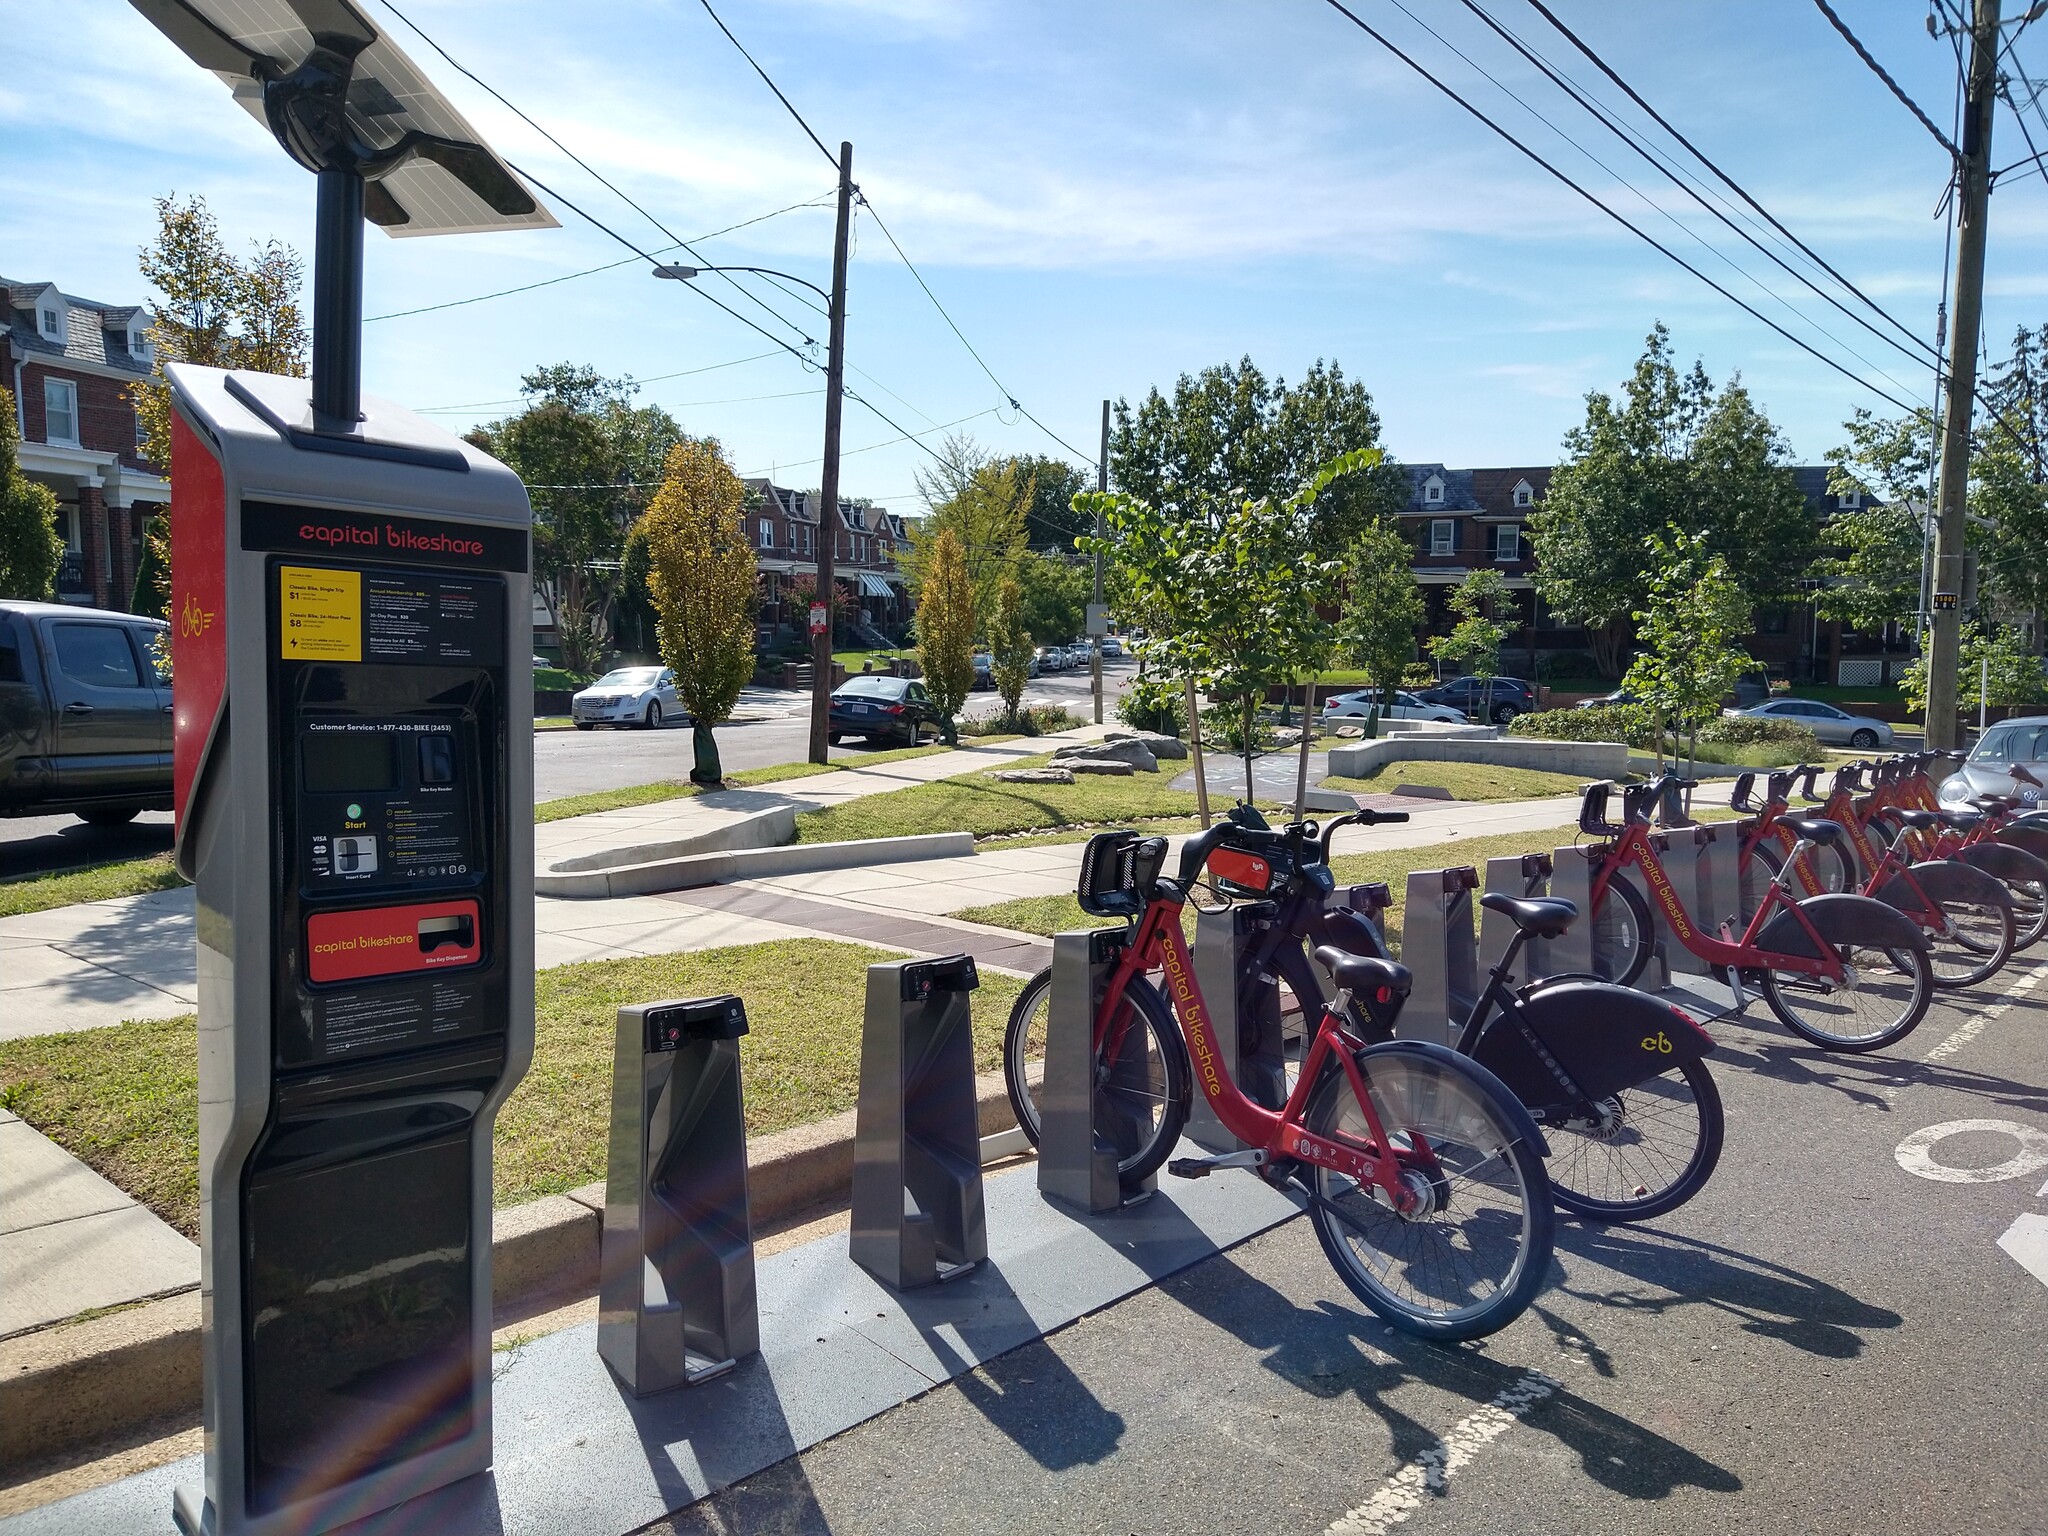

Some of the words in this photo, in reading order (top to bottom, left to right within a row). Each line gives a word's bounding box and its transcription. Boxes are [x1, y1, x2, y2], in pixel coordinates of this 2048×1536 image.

[299, 525, 378, 547] capital
[386, 523, 484, 555] bikeshare
[289, 592, 299, 600] $1
[290, 619, 301, 627] $8
[430, 724, 452, 732] (2453)
[1252, 862, 1264, 871] lyft
[1639, 847, 1666, 886] capital
[1660, 886, 1690, 939] bikeshare
[314, 938, 356, 954] capital
[359, 934, 413, 948] bikeshare
[446, 954, 468, 962] Dispenser
[1162, 937, 1195, 1002] capital
[1185, 1004, 1221, 1096] bikeshare
